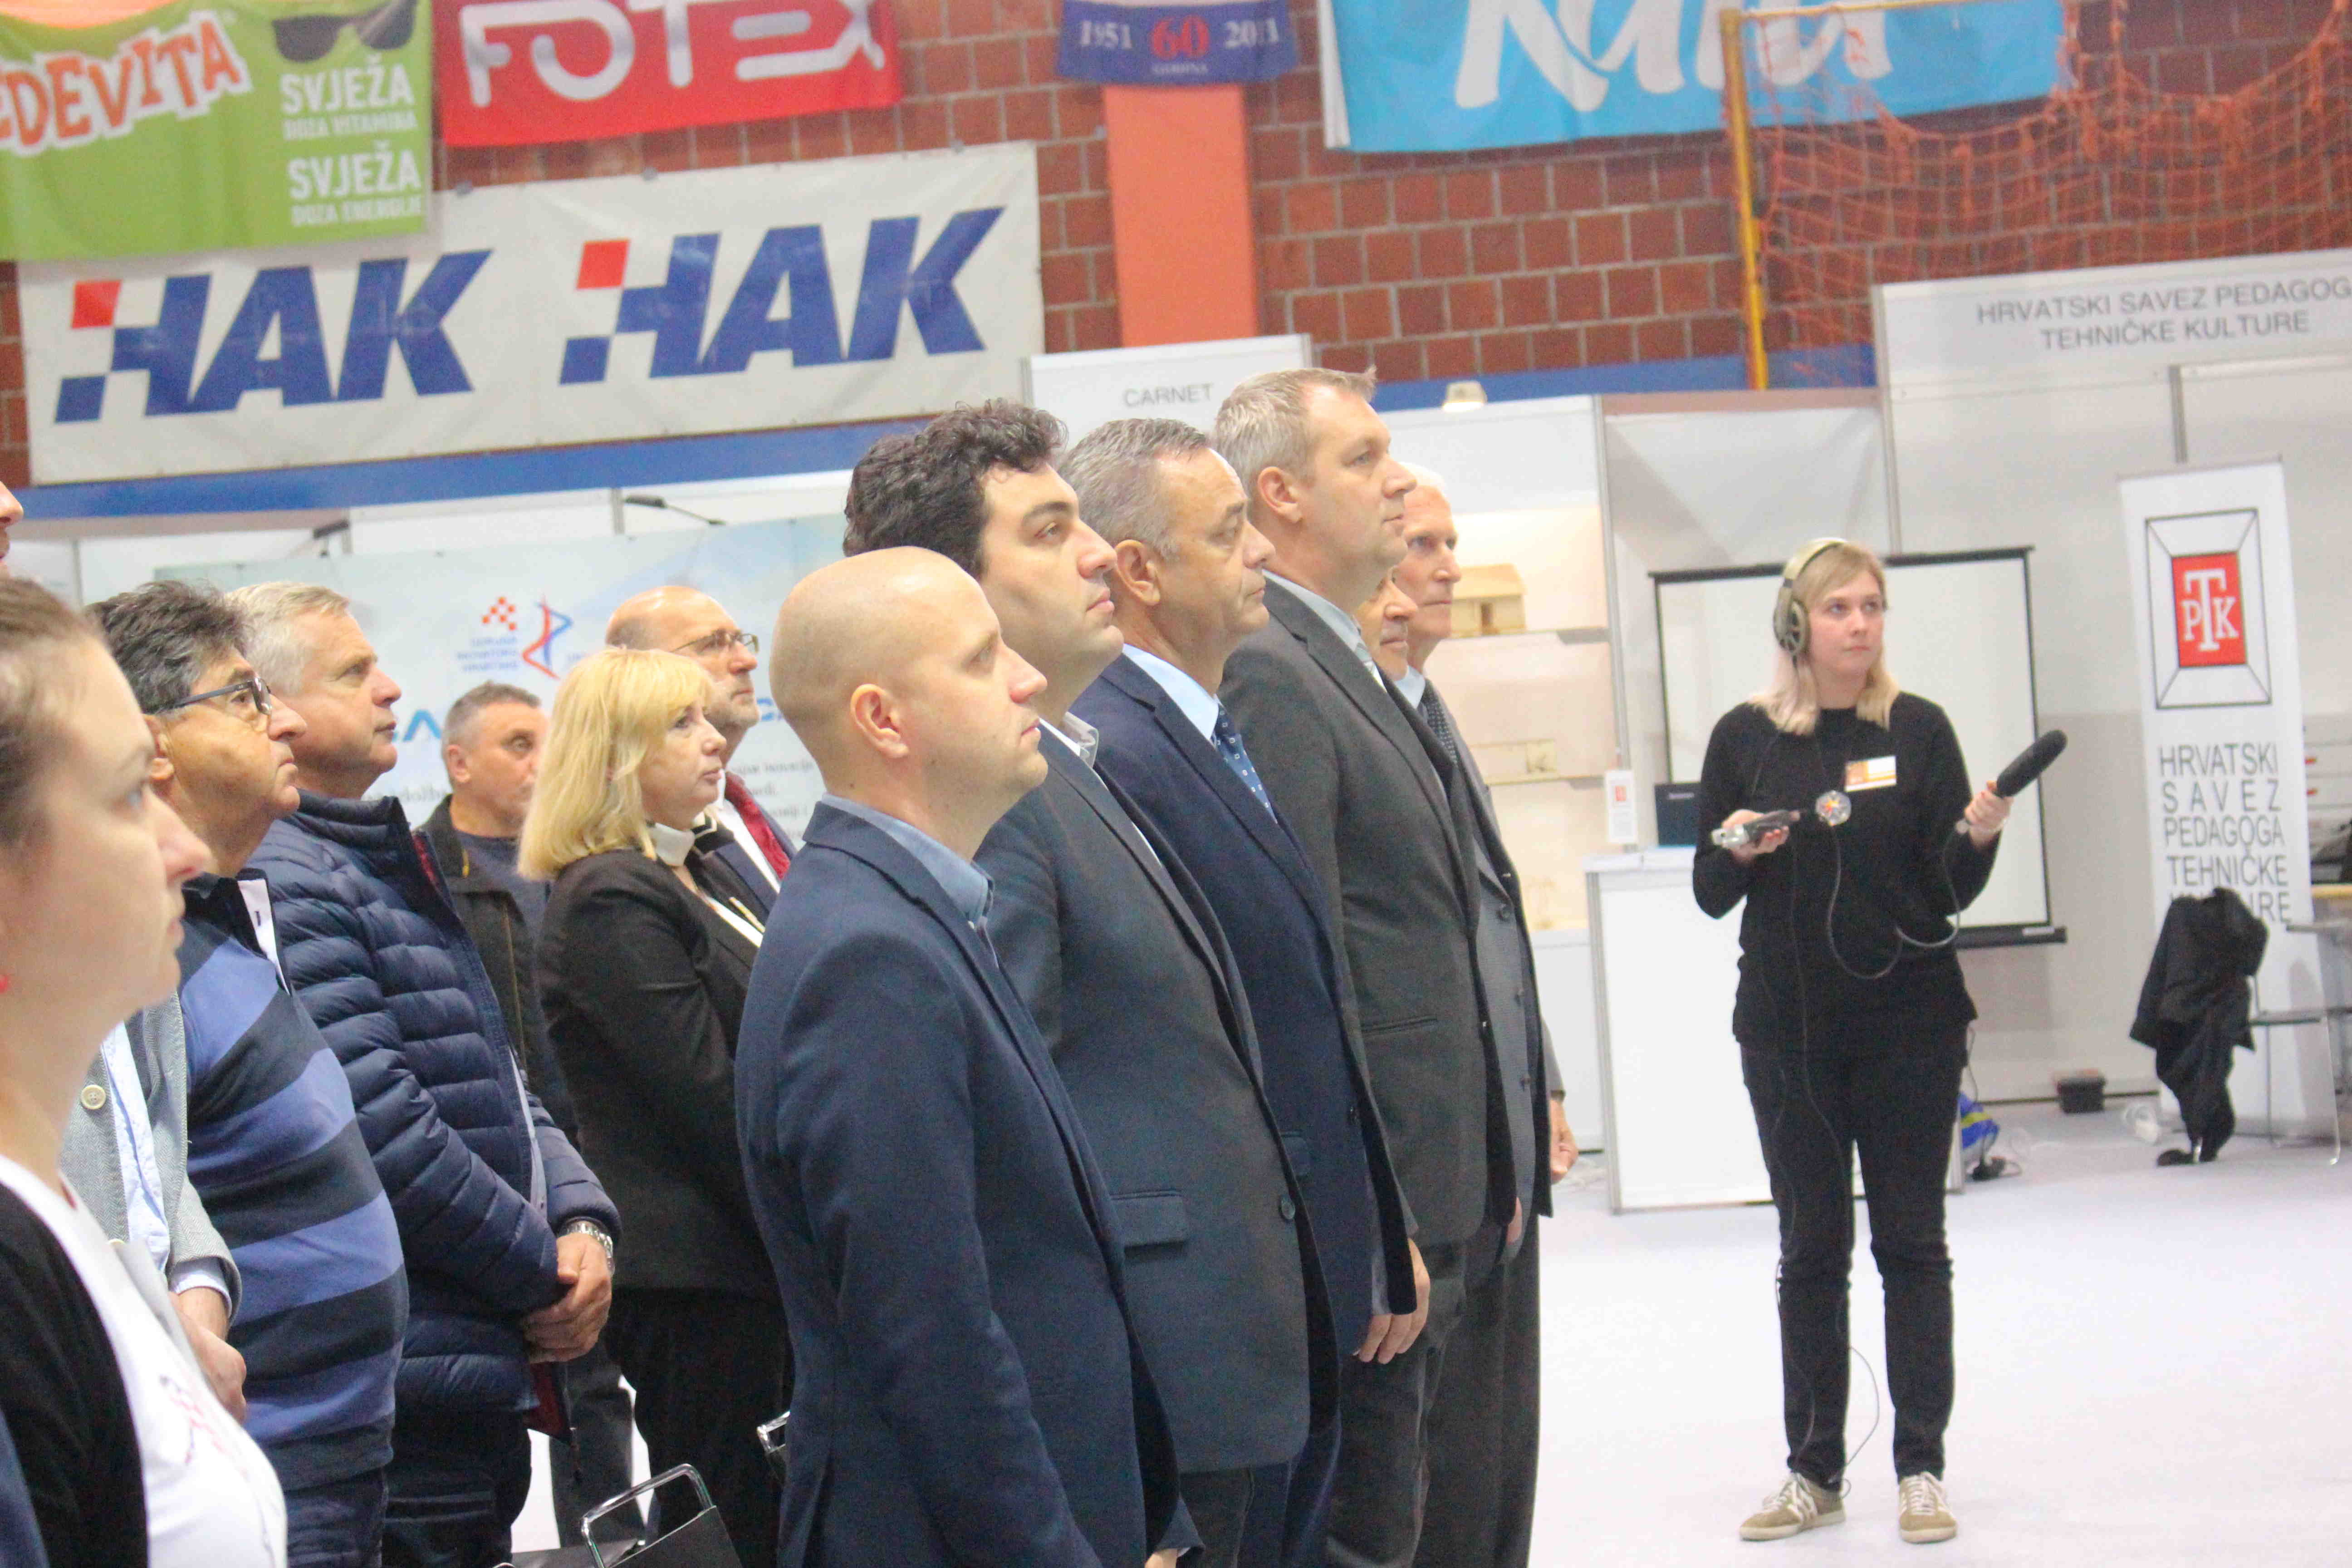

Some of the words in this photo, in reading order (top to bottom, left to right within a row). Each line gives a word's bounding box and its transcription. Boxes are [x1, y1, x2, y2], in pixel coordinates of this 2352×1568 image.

[1149, 15, 1210, 61] 60
[0, 19, 243, 147] DEVITA
[281, 54, 414, 113] SVJEŽA
[288, 140, 421, 199] SVJEŽA
[559, 206, 1006, 385] HAK
[1976, 294, 2111, 325] HRVATSKI
[2120, 288, 2207, 314] SAVEZ
[55, 249, 495, 423] HAK
[2041, 316, 2176, 351] TEHNIČKE
[2185, 309, 2310, 340] KULTURE
[1123, 384, 1213, 407] CARNET
[2158, 743, 2279, 777] HRVATSKI
[2162, 779, 2282, 813] SAVEZ
[2164, 814, 2286, 848] PEDAGOGA
[2166, 846, 2288, 887] TEHNIČKE
